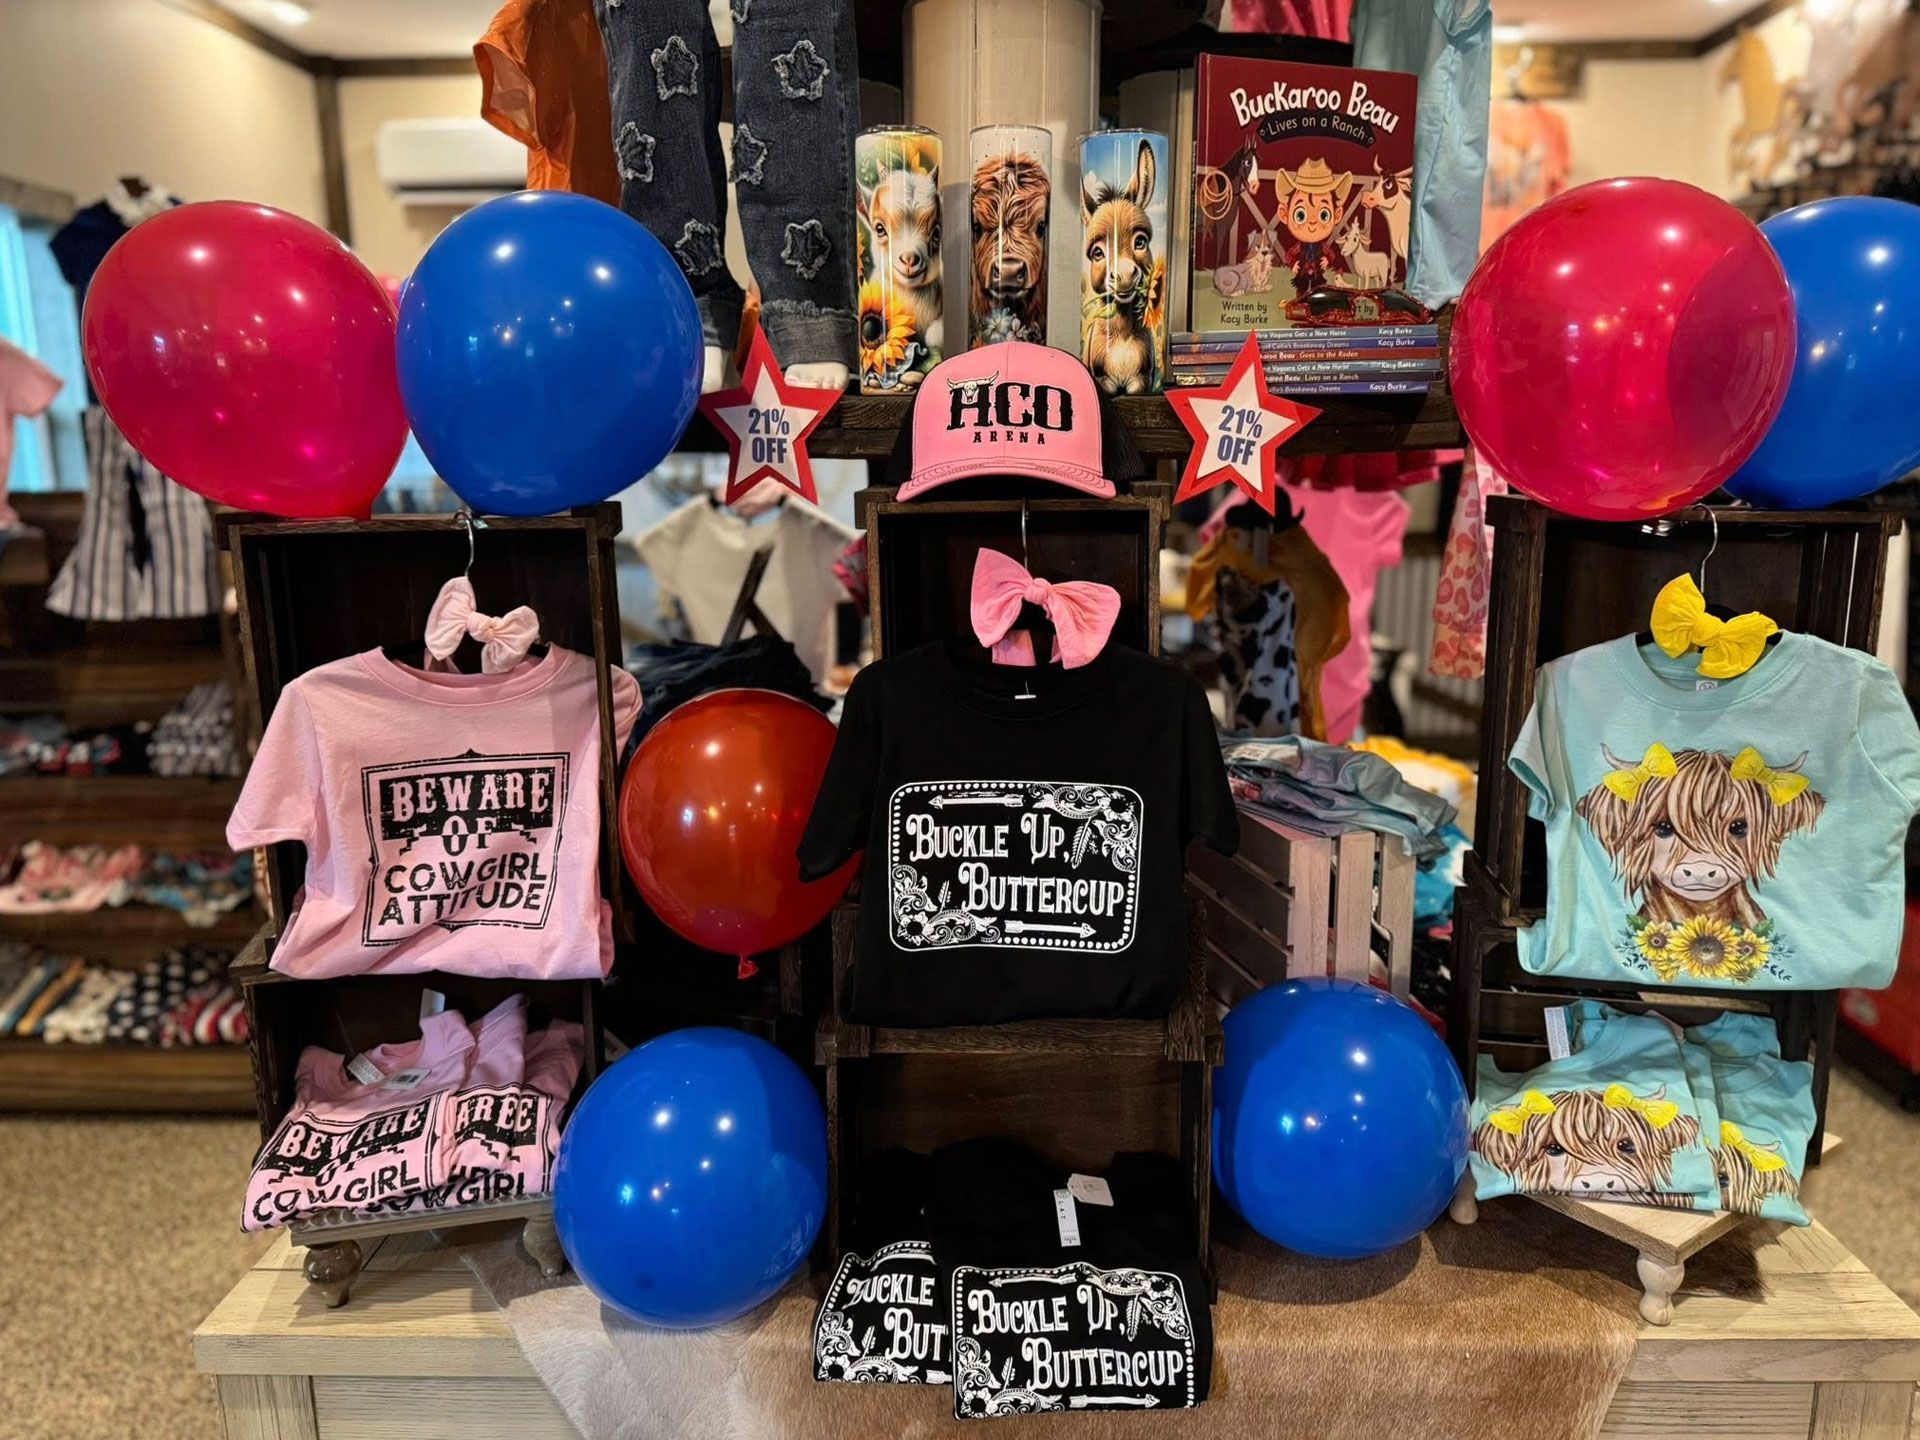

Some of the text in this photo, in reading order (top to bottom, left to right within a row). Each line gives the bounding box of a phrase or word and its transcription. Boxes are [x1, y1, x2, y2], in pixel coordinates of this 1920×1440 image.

[1346, 81, 1399, 134] Beau
[1268, 115, 1366, 140] Lives on a Ranch
[1220, 313, 1269, 326] Kacy Burke
[1222, 301, 1268, 314] Written by
[1377, 339, 1394, 347] Kacy
[1395, 338, 1416, 346] Burke
[1304, 373, 1321, 381] Lives
[1369, 383, 1385, 391] Kacy
[748, 407, 790, 436] 21%
[946, 380, 1074, 432] HCO
[1218, 404, 1262, 438] 21%
[751, 437, 788, 464] OFF
[972, 430, 1046, 445] ARENA
[1217, 434, 1256, 466] OFF
[391, 771, 550, 823] BEWARE
[441, 815, 498, 857] OF
[384, 852, 547, 894] COWGIRL
[378, 882, 545, 926] ATTITUDE
[276, 1104, 428, 1162] BEWARE
[314, 1147, 367, 1188] OF
[253, 1160, 419, 1222] COWGIRL
